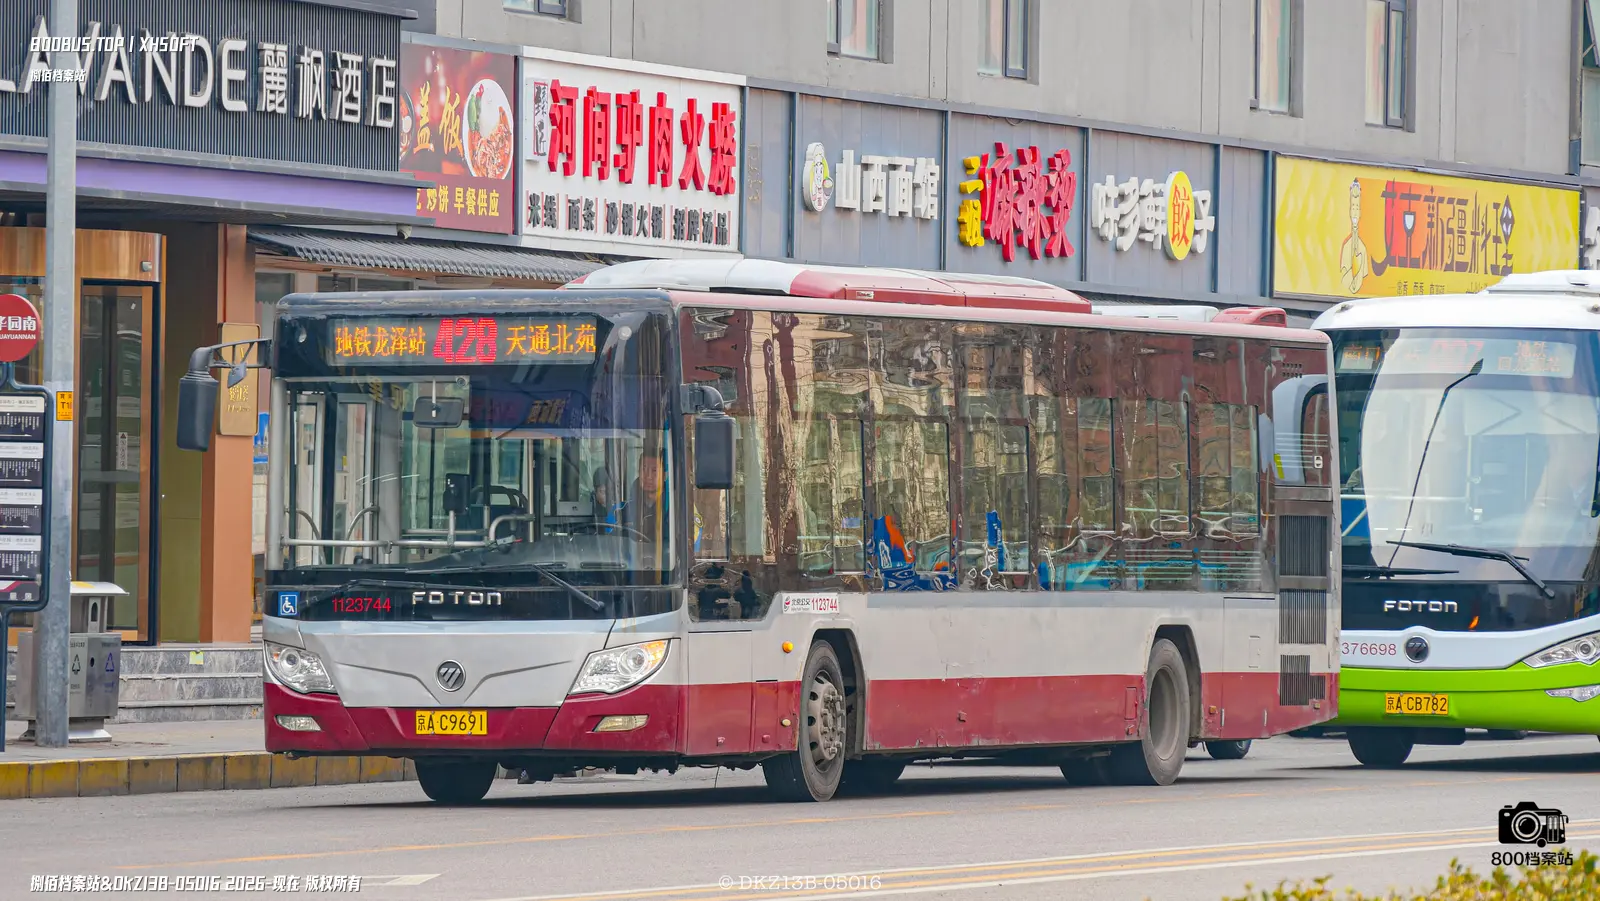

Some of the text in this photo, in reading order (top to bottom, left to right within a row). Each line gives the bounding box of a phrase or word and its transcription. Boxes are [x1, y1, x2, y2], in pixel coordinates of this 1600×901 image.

[257, 42, 396, 128] 麗枫酒店
[413, 81, 464, 157] 盖饭
[548, 79, 736, 196] 河间驴肉火烧
[454, 187, 500, 217] 早餐供应
[835, 149, 939, 219] 山西面馆
[529, 192, 729, 246] 米线 面条 砂锅火锅 招牌汤品
[335, 318, 597, 363] 地铁龙泽站 428 天通北苑
[332, 591, 502, 612] 1123744 FOTON
[812, 598, 838, 611] 1123744
[1383, 600, 1458, 613] FOTON
